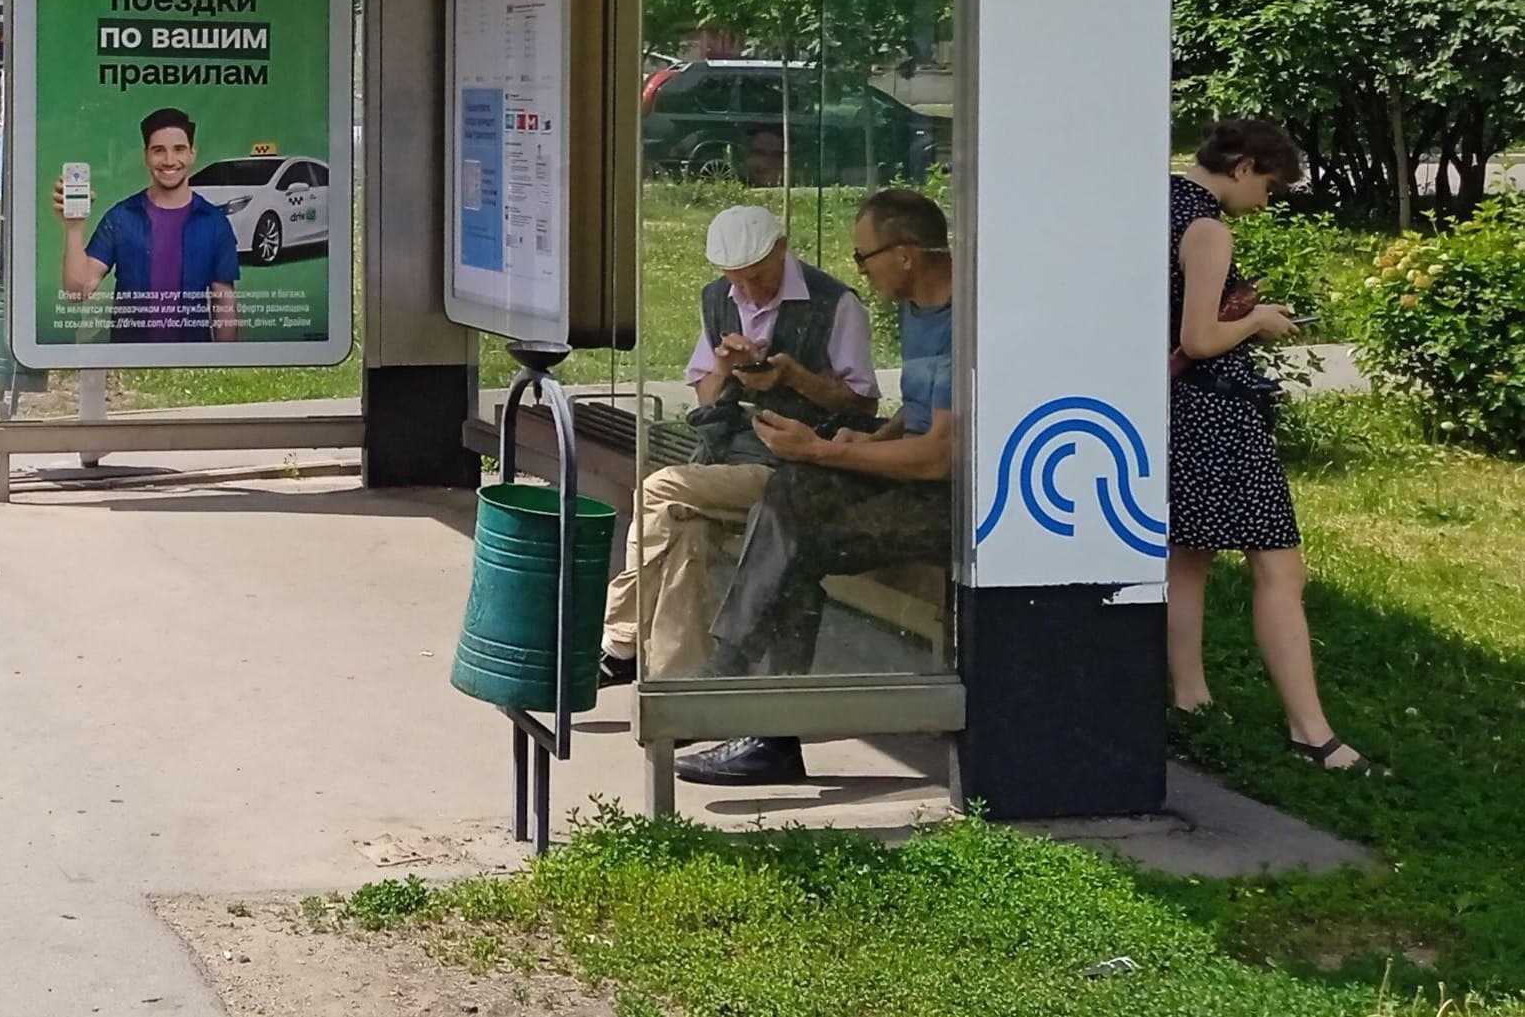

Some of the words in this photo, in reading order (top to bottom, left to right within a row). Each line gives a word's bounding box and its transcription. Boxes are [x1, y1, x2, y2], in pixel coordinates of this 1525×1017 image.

[100, 27, 142, 48] по
[151, 27, 267, 49] вашим
[99, 63, 268, 92] правилам
